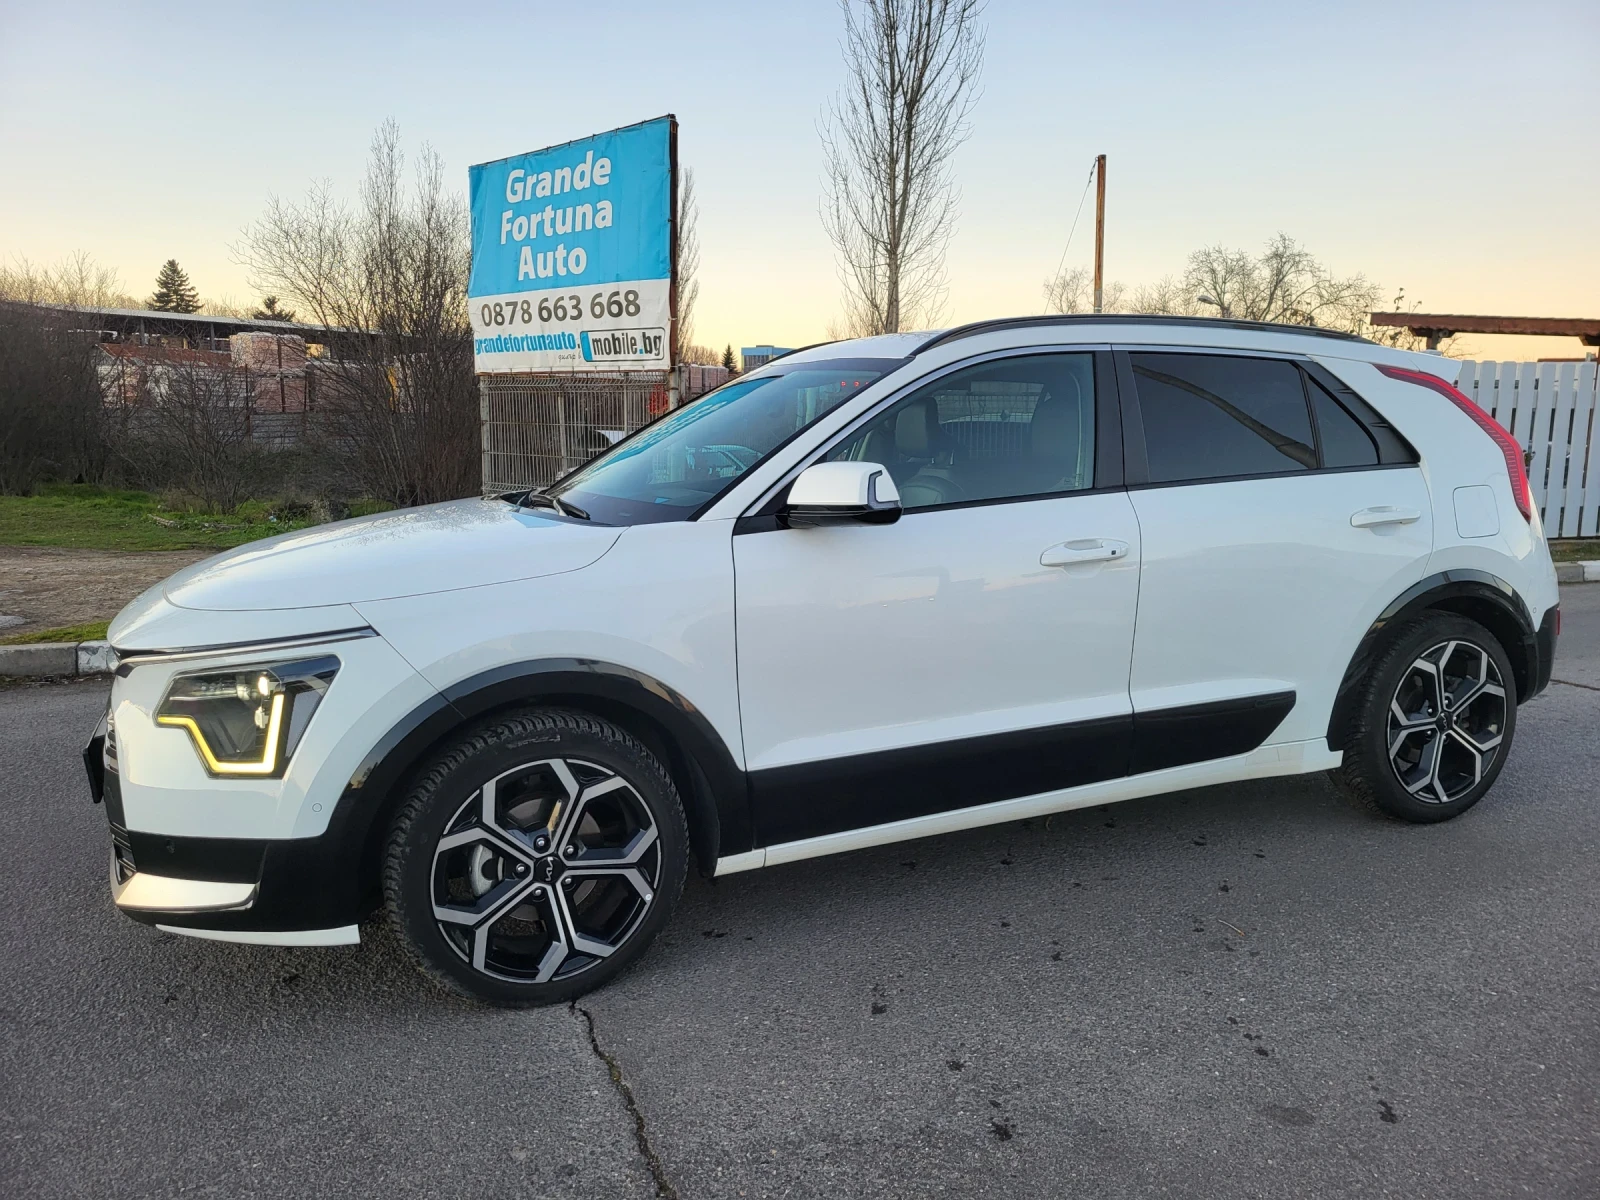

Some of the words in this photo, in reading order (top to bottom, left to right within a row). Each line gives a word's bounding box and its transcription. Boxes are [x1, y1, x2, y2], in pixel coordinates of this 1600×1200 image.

[506, 150, 611, 203] Grande
[500, 200, 613, 245] Fortuna
[518, 243, 587, 281] Auto
[481, 300, 532, 326] 0878
[538, 295, 582, 322] 663
[590, 290, 640, 319] 668
